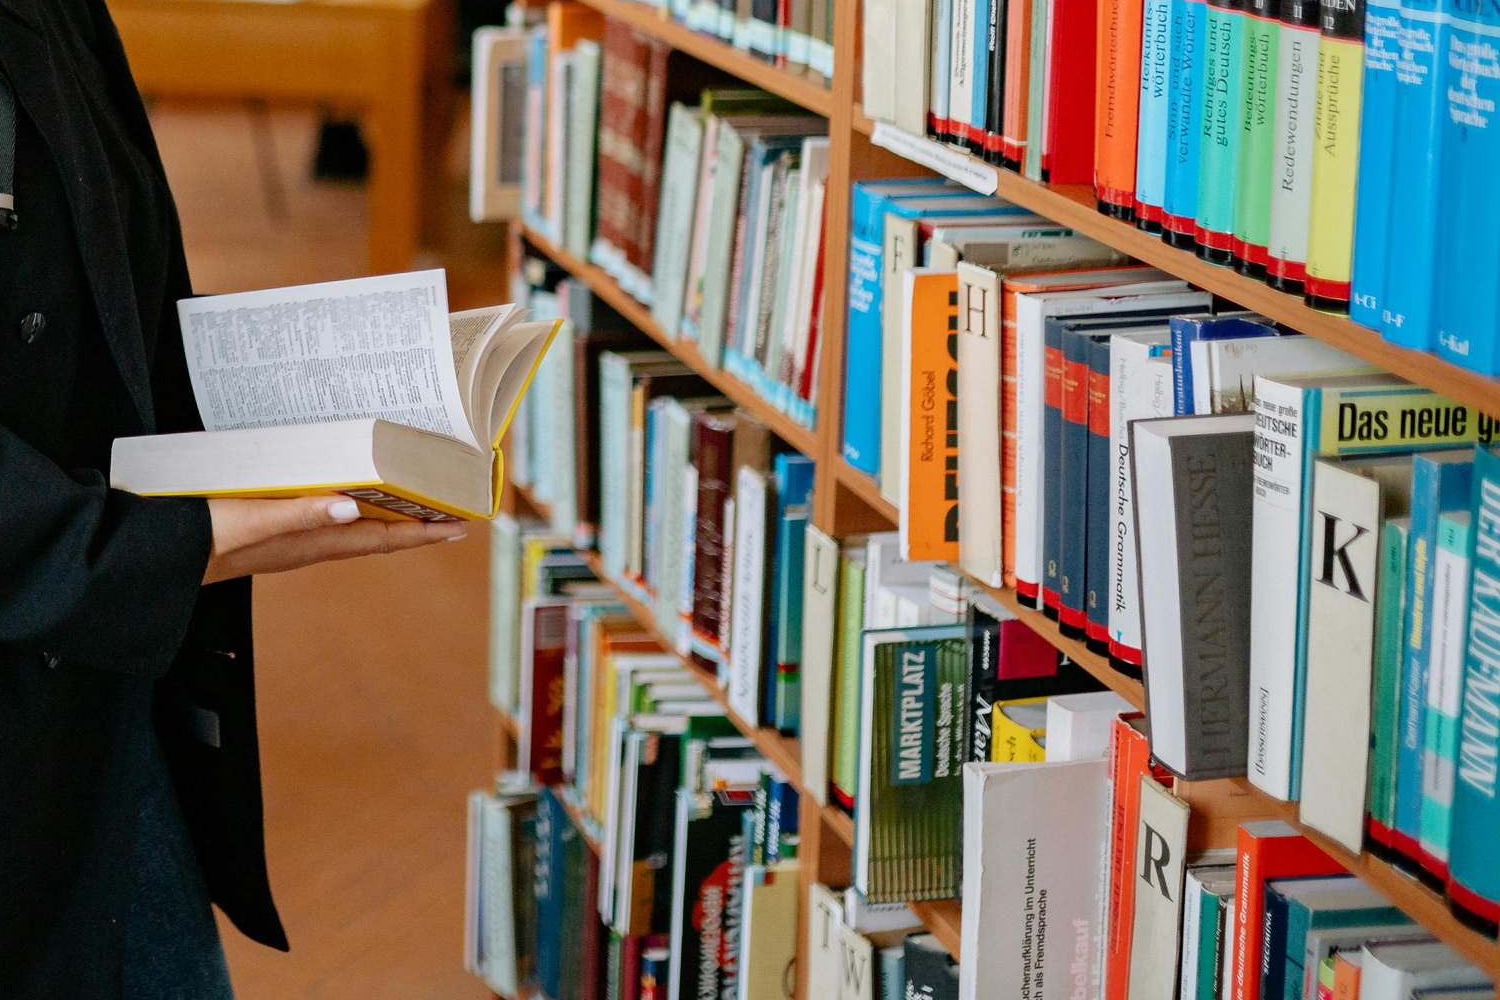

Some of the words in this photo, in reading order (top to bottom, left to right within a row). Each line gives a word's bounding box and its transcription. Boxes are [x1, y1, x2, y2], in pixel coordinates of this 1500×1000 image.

[1175, 8, 1183, 51] sach-
[1292, 5, 1303, 19] 11
[1323, 15, 1335, 30] 12
[1141, 0, 1154, 91] Herkunfts-
[1151, 3, 1168, 99] wörterbuch
[1182, 11, 1196, 72] Wörter
[1216, 22, 1232, 96] Deutsch
[1317, 51, 1326, 83] und
[1372, 35, 1384, 49] der
[1401, 48, 1415, 61] der
[1450, 34, 1467, 53] Das
[1466, 39, 1499, 62] große
[1172, 57, 1180, 91] und
[1203, 58, 1217, 138] Richtiges
[1210, 18, 1218, 53] und
[1244, 30, 1258, 133] Bedeutungs-
[1253, 33, 1270, 126] wörterbuch
[1460, 72, 1478, 92] der
[1168, 94, 1177, 141] Sinn-
[1178, 76, 1194, 164] verwandte
[1216, 99, 1229, 148] gutes
[1281, 40, 1304, 193] Redewendungen
[1323, 53, 1341, 157] Aussprüche
[1449, 103, 1489, 129] Sprache
[892, 233, 905, 274] F
[963, 282, 990, 340] H
[921, 370, 936, 413] Göbel
[1117, 357, 1129, 440] Helbig/Buscha
[1151, 373, 1164, 418] Helbig/
[1175, 330, 1184, 415] teraturlexikon
[920, 414, 936, 463] Richard
[1262, 401, 1277, 412] neue
[1278, 405, 1299, 418] große
[1337, 402, 1389, 442] Das
[1399, 405, 1467, 440] neue
[1253, 449, 1273, 472] BUCH
[1254, 432, 1292, 459] WÖRTER-
[346, 489, 447, 521] DUDEN
[1116, 444, 1129, 517] Deutsche
[1186, 452, 1224, 558] HESSE
[812, 541, 828, 595] L
[1115, 521, 1128, 613] Grammatik
[1315, 509, 1372, 604] K
[1414, 571, 1425, 597] und
[1194, 573, 1231, 756] HERMANN
[1410, 658, 1421, 702] Kaiser
[1458, 567, 1500, 799] KAUFMANN
[899, 649, 926, 781] MARKTPLATZ
[938, 681, 954, 725] Sprache
[973, 692, 992, 762] Mar
[1404, 704, 1420, 750] Gerhard
[934, 726, 952, 779] Deutsche
[1024, 836, 1037, 895] Unterricht
[1139, 818, 1174, 904] R
[1239, 852, 1250, 924] Grammatik
[1024, 896, 1034, 912] im
[1034, 888, 1048, 970] Fremdsprache
[838, 937, 868, 995] W
[1021, 912, 1035, 1000] ucheraufklärung
[1070, 918, 1090, 1000] belkauf
[1236, 925, 1247, 987] deutsche
[1263, 911, 1273, 975] SPECIMINA
[1035, 971, 1044, 989] als
